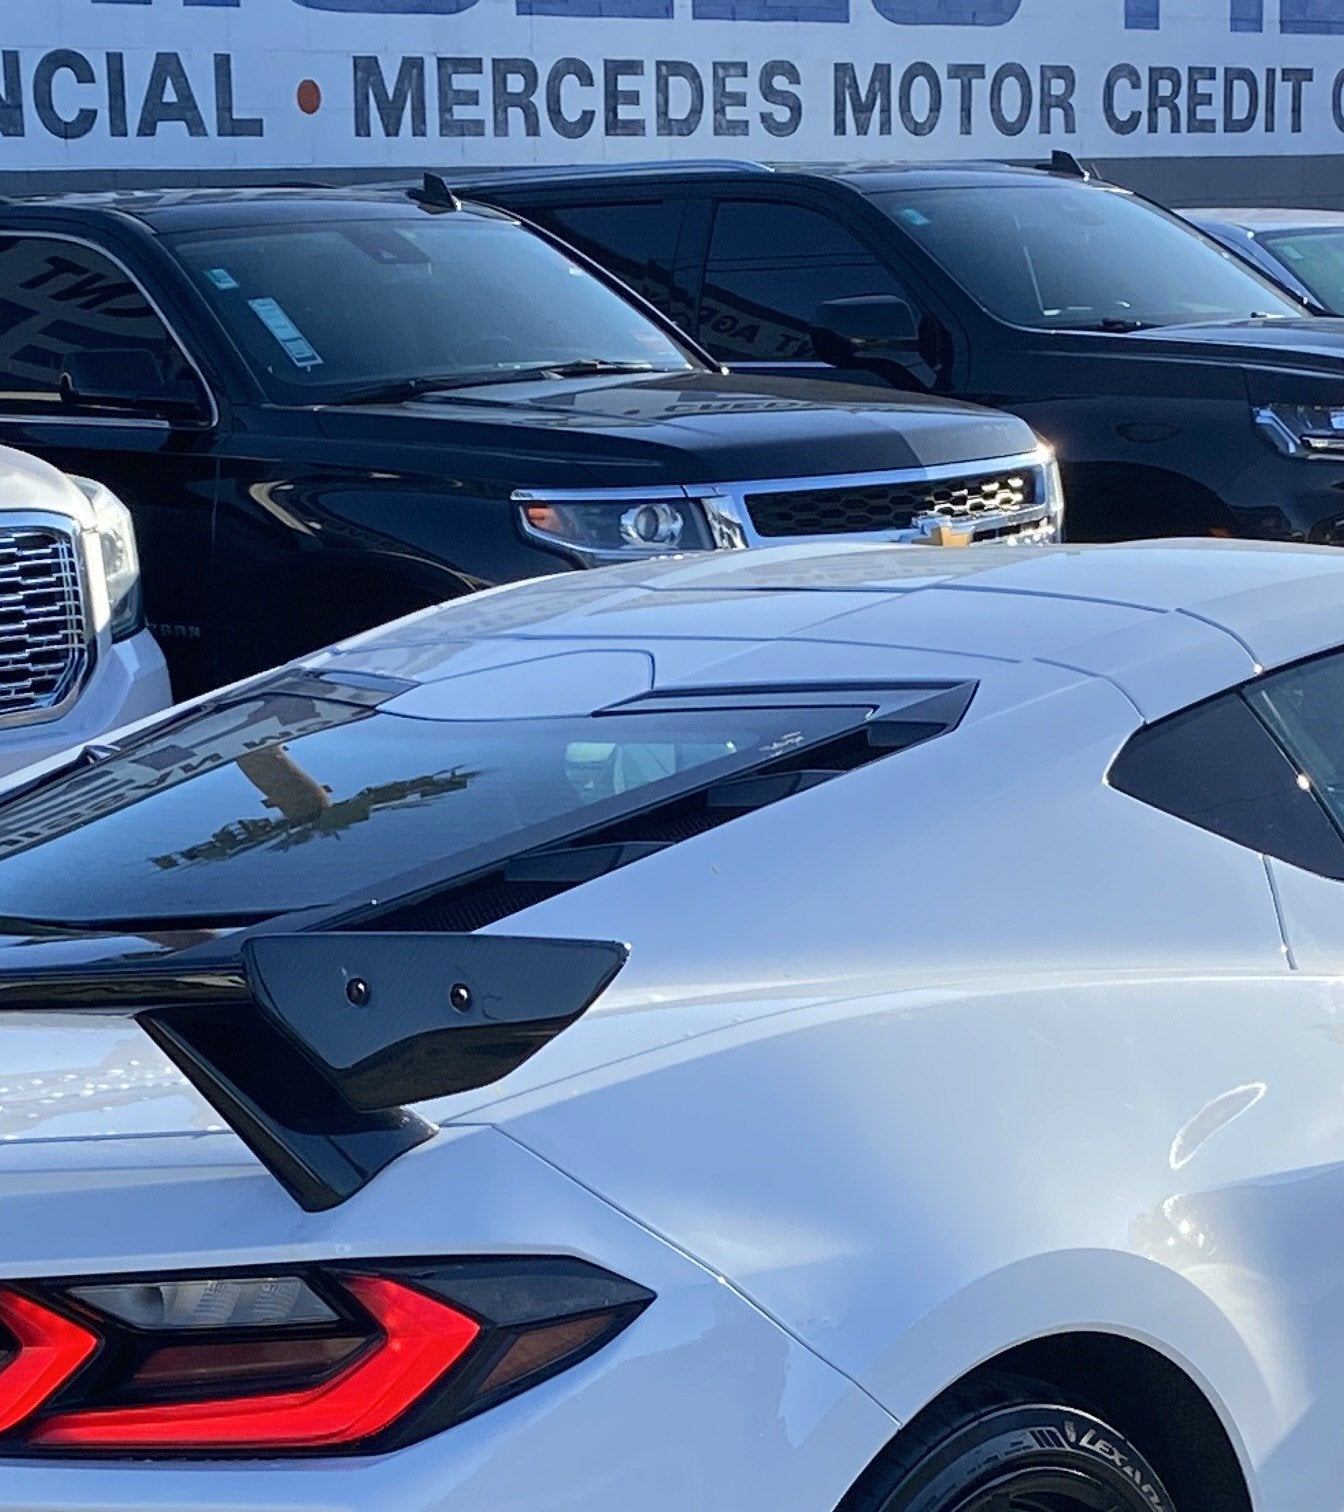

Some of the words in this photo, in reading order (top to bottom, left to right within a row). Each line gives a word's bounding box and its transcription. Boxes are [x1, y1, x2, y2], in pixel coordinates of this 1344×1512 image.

[351, 54, 803, 140] MERCEDES
[833, 62, 1077, 137] MOTOR
[1102, 63, 1314, 136] CREDIT
